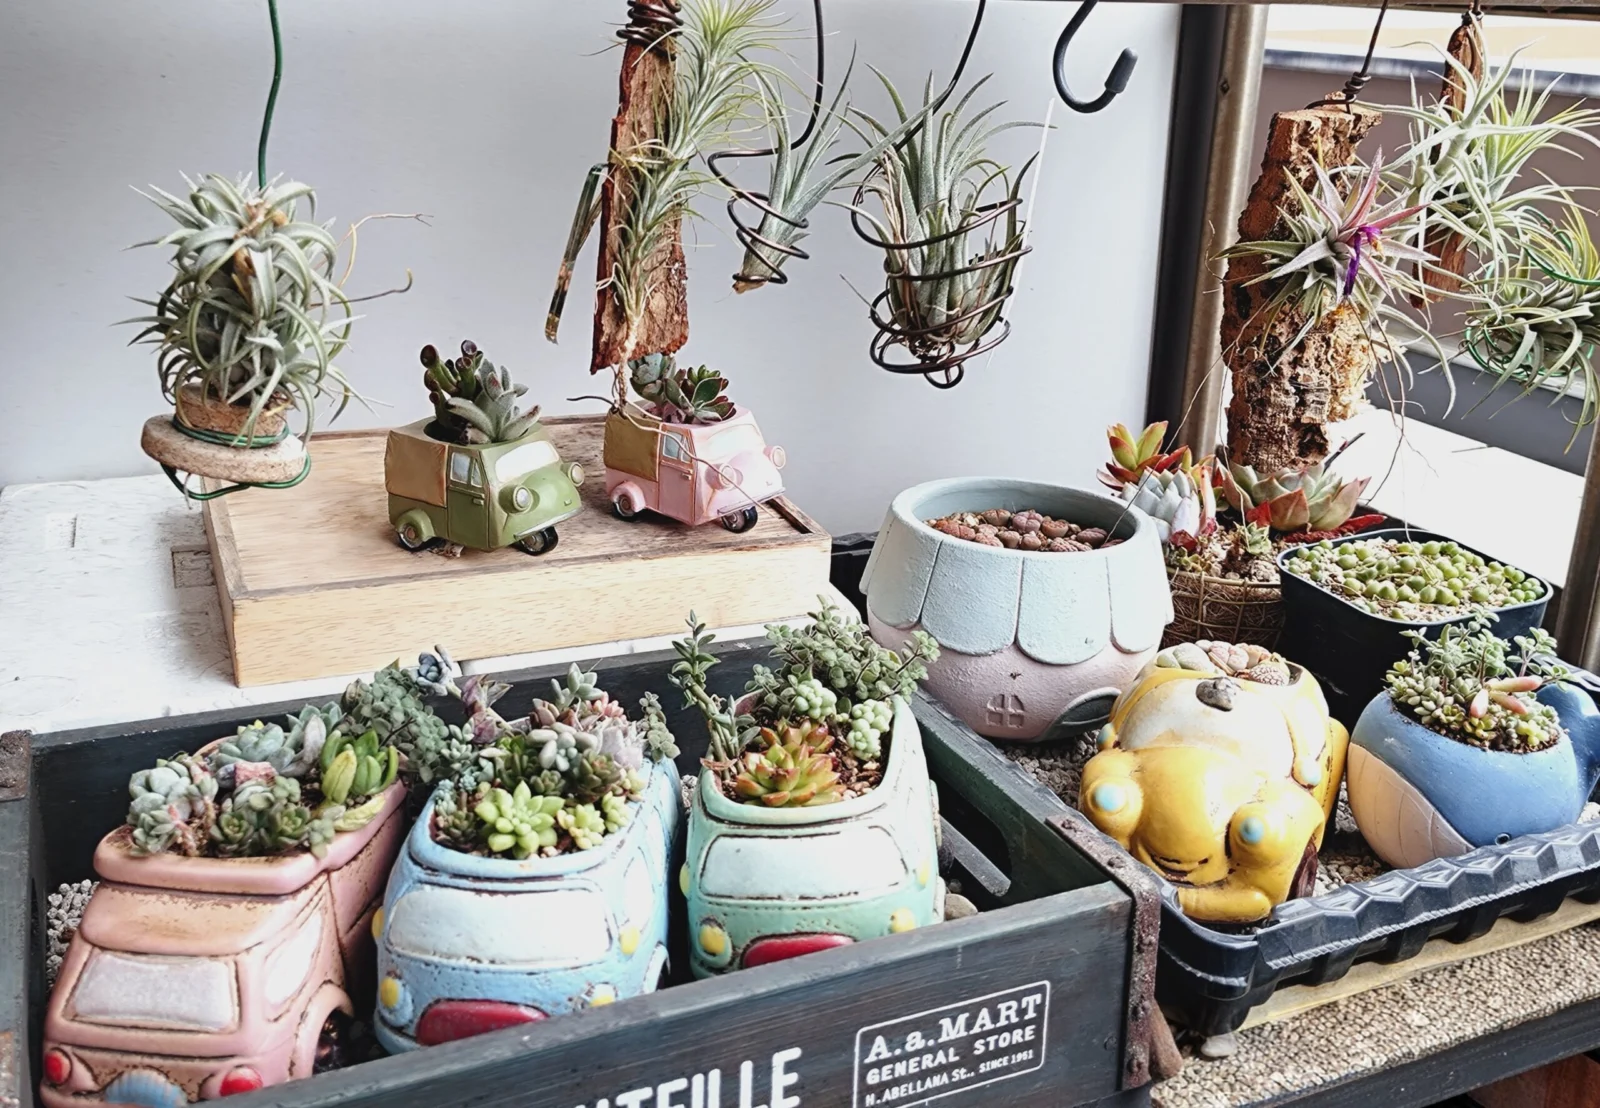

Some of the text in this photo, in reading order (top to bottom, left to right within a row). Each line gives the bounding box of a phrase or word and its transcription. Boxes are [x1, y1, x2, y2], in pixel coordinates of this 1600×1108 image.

[866, 1025, 1036, 1085] GENERAL STORE
[979, 1056, 1009, 1073] SINCE
[1011, 1049, 1034, 1063] 1951
